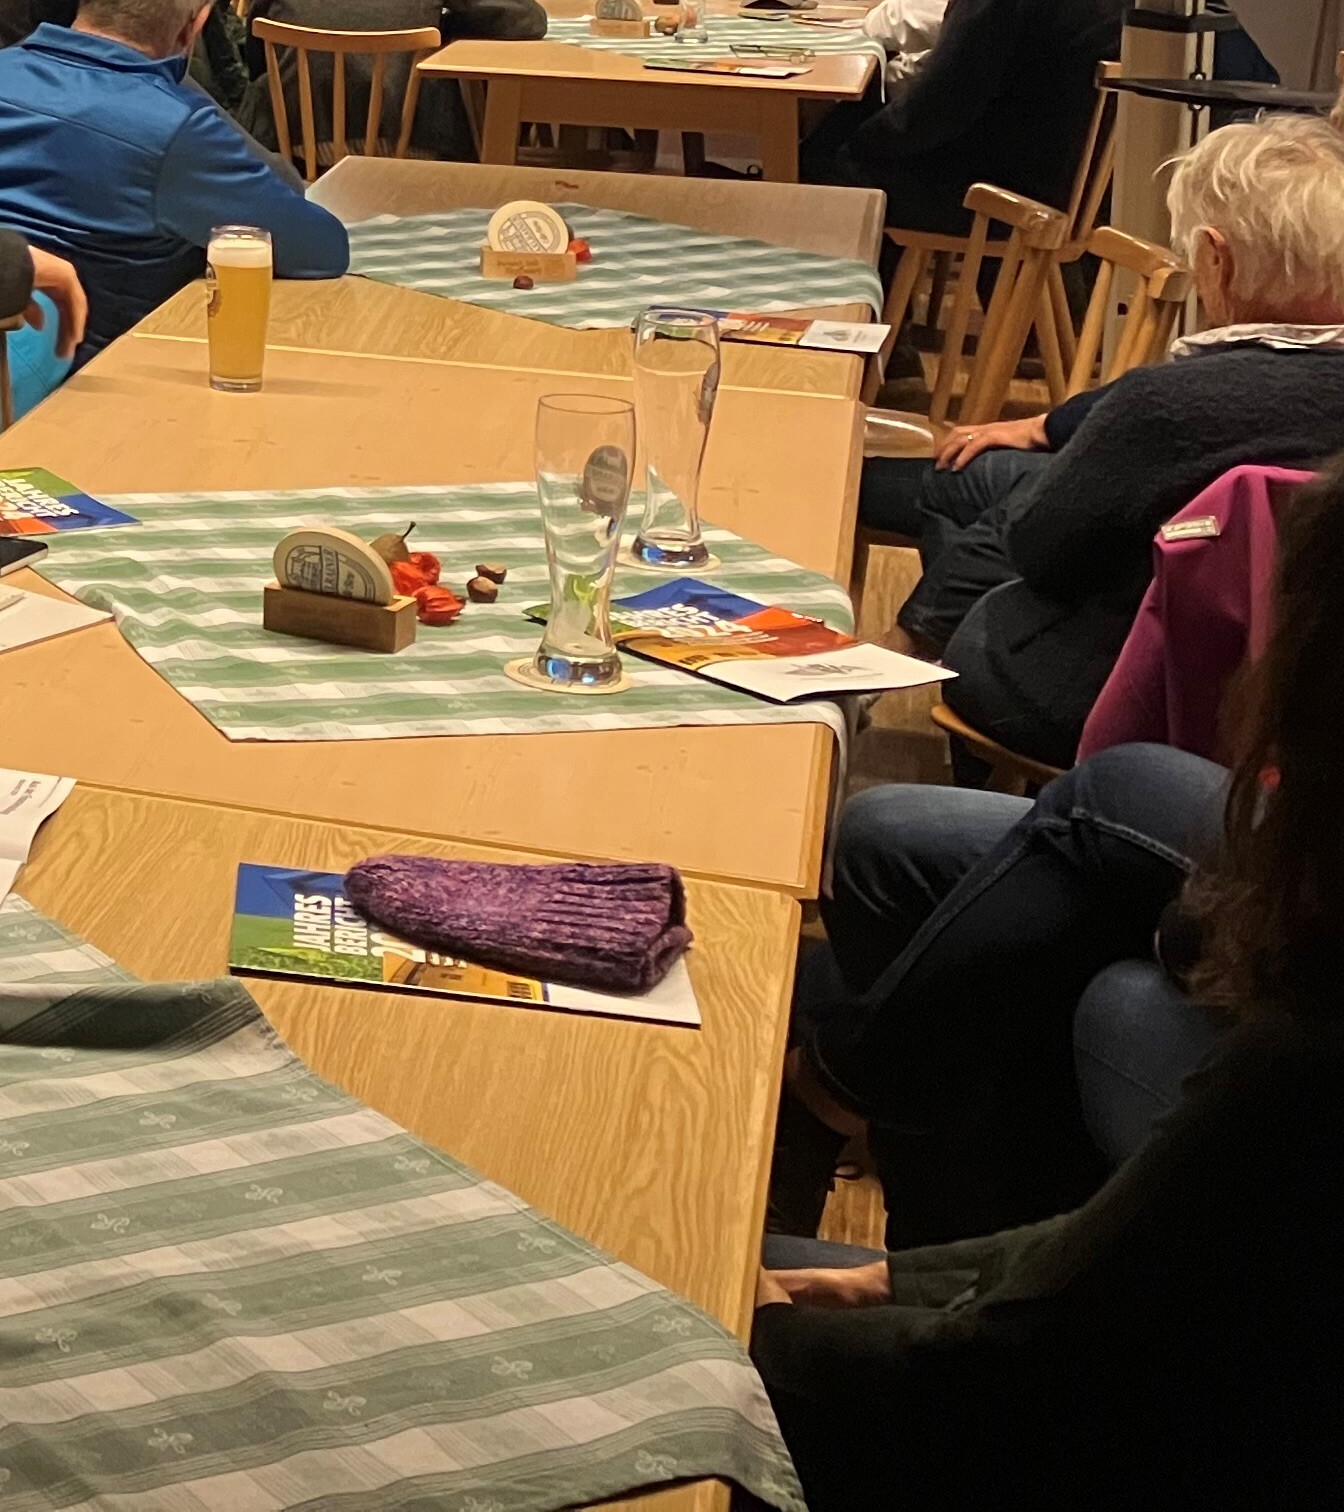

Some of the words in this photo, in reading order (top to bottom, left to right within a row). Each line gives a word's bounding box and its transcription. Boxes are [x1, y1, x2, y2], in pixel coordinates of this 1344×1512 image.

[1, 478, 80, 516] JAHRES
[640, 619, 753, 638] 2024
[293, 893, 332, 954] JAHRES
